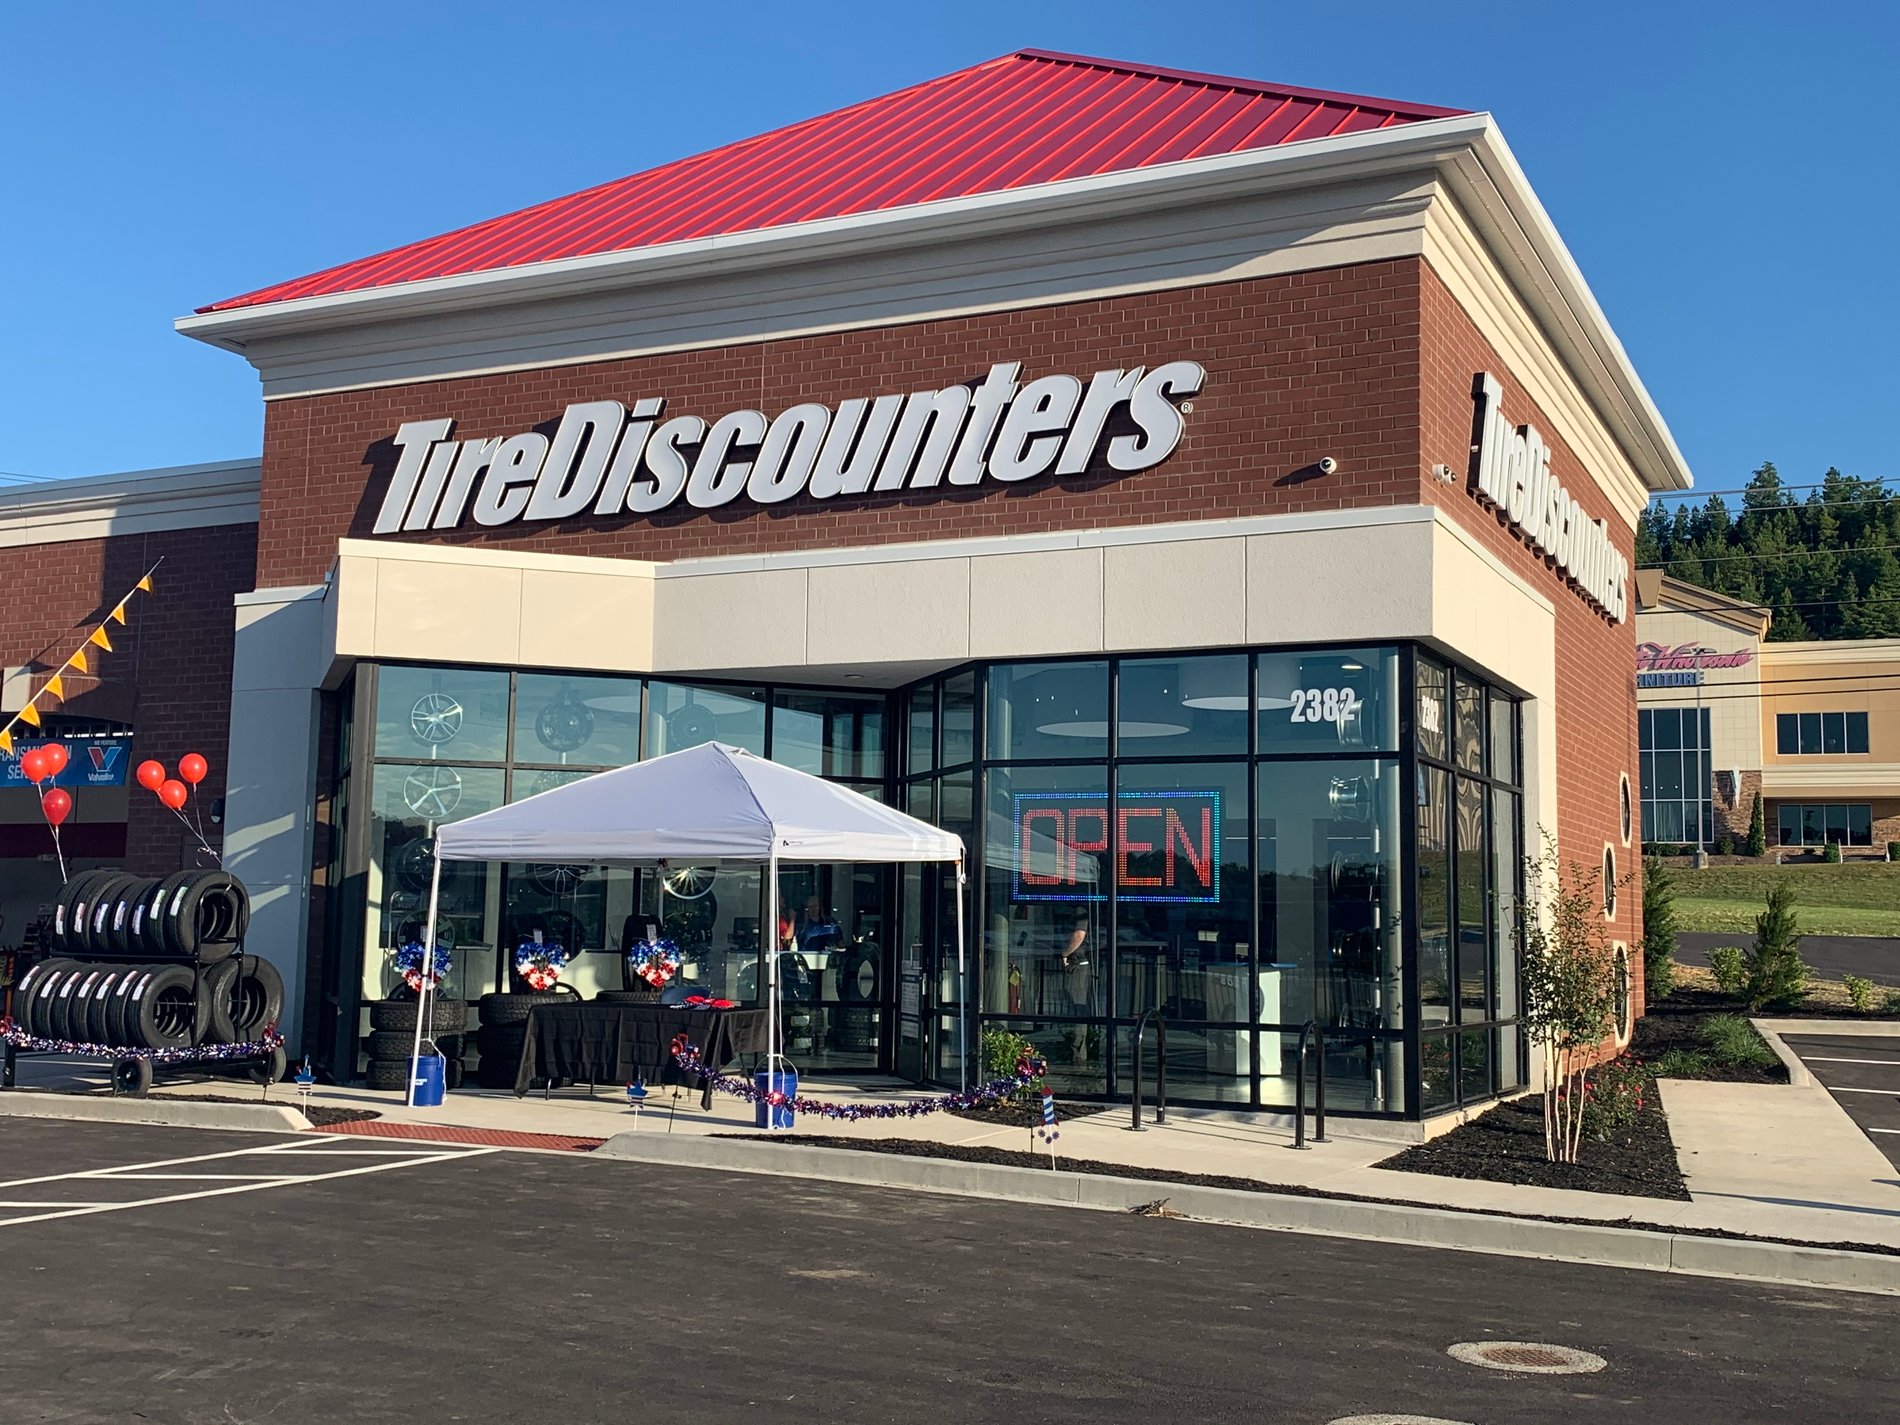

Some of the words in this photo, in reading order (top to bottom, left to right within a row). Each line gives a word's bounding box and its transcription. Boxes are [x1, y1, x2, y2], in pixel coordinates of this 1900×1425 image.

[1290, 687, 1356, 723] 2382
[1421, 695, 1440, 734] 2382
[1022, 806, 1211, 888] OPEN
